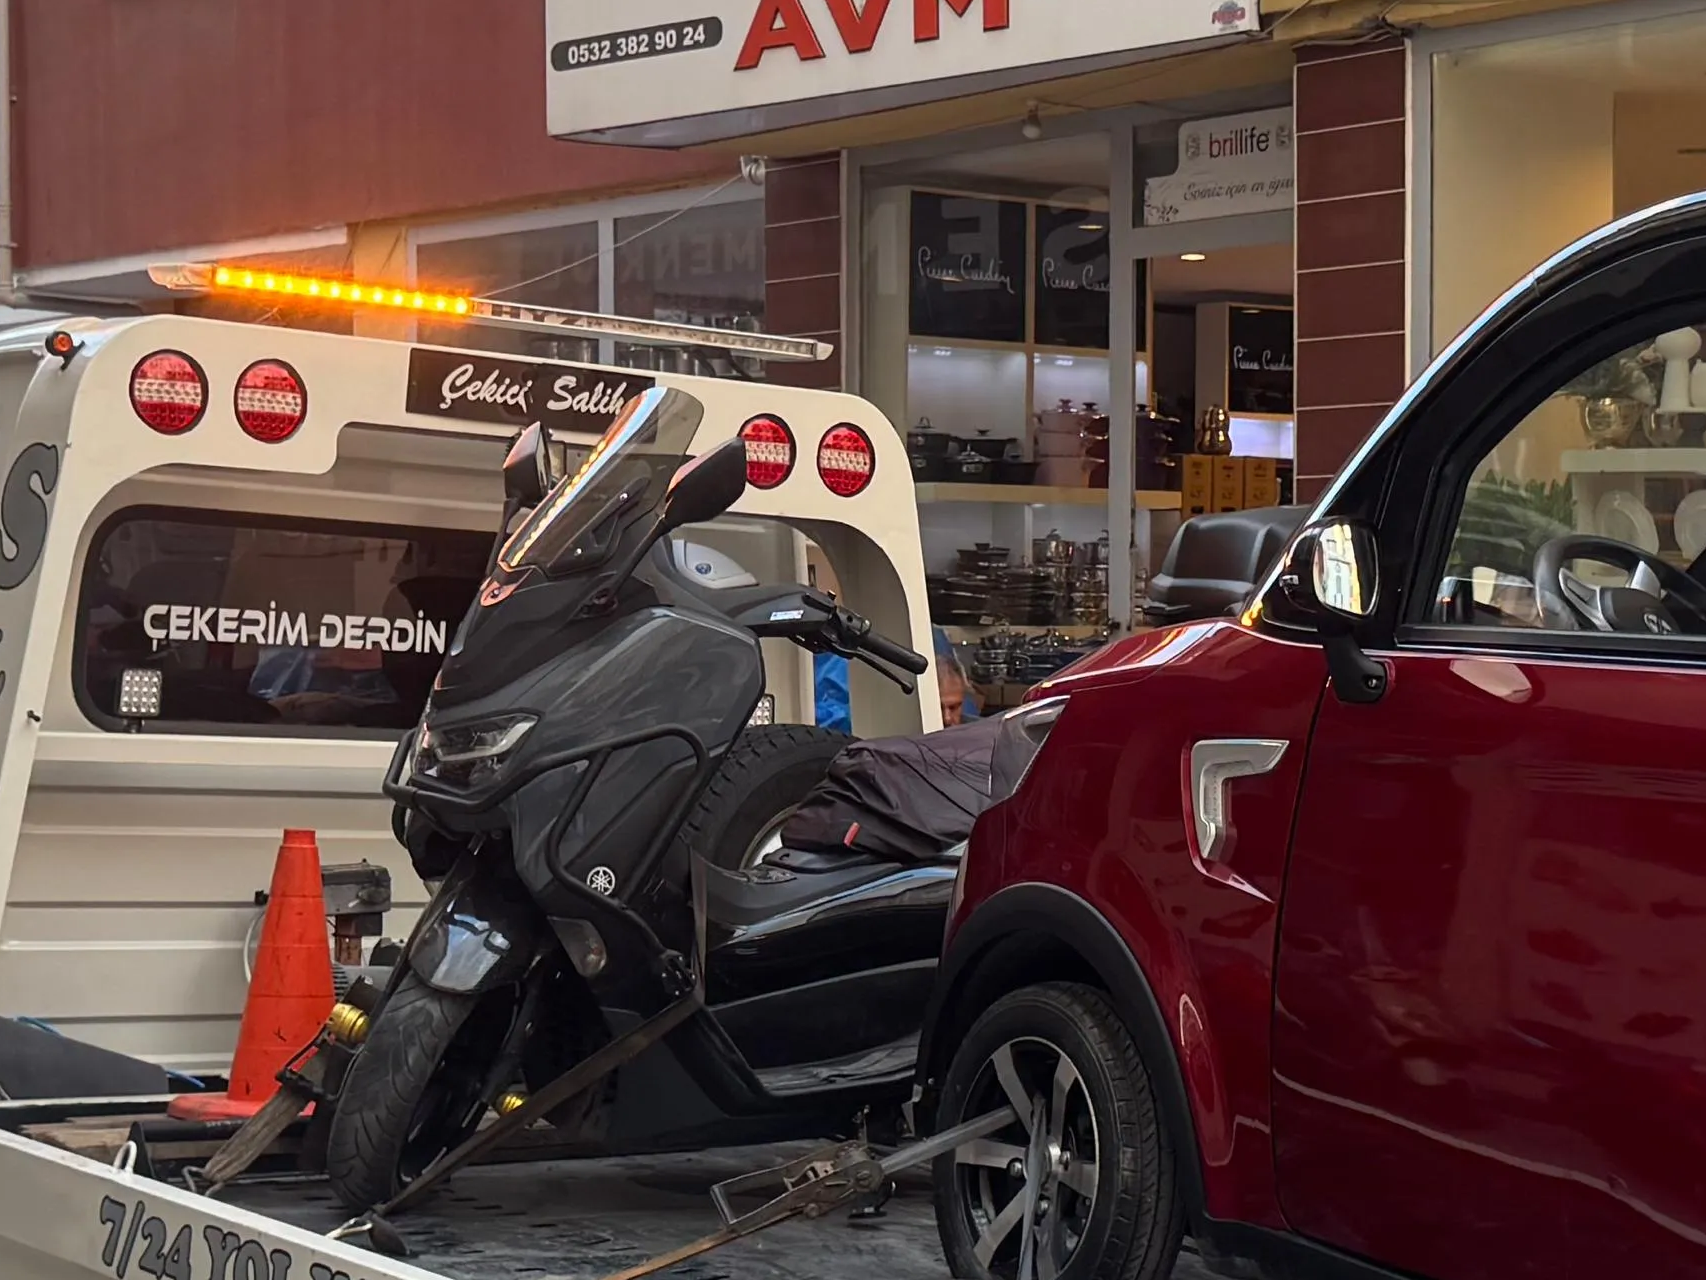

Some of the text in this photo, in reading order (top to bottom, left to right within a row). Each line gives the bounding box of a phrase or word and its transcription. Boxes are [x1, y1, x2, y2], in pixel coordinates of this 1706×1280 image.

[567, 24, 706, 65] 0532 382 90 24
[1208, 126, 1270, 159] brillife
[439, 363, 627, 416] Çekici Salih
[143, 600, 447, 655] ÇEKERİM DERDİN
